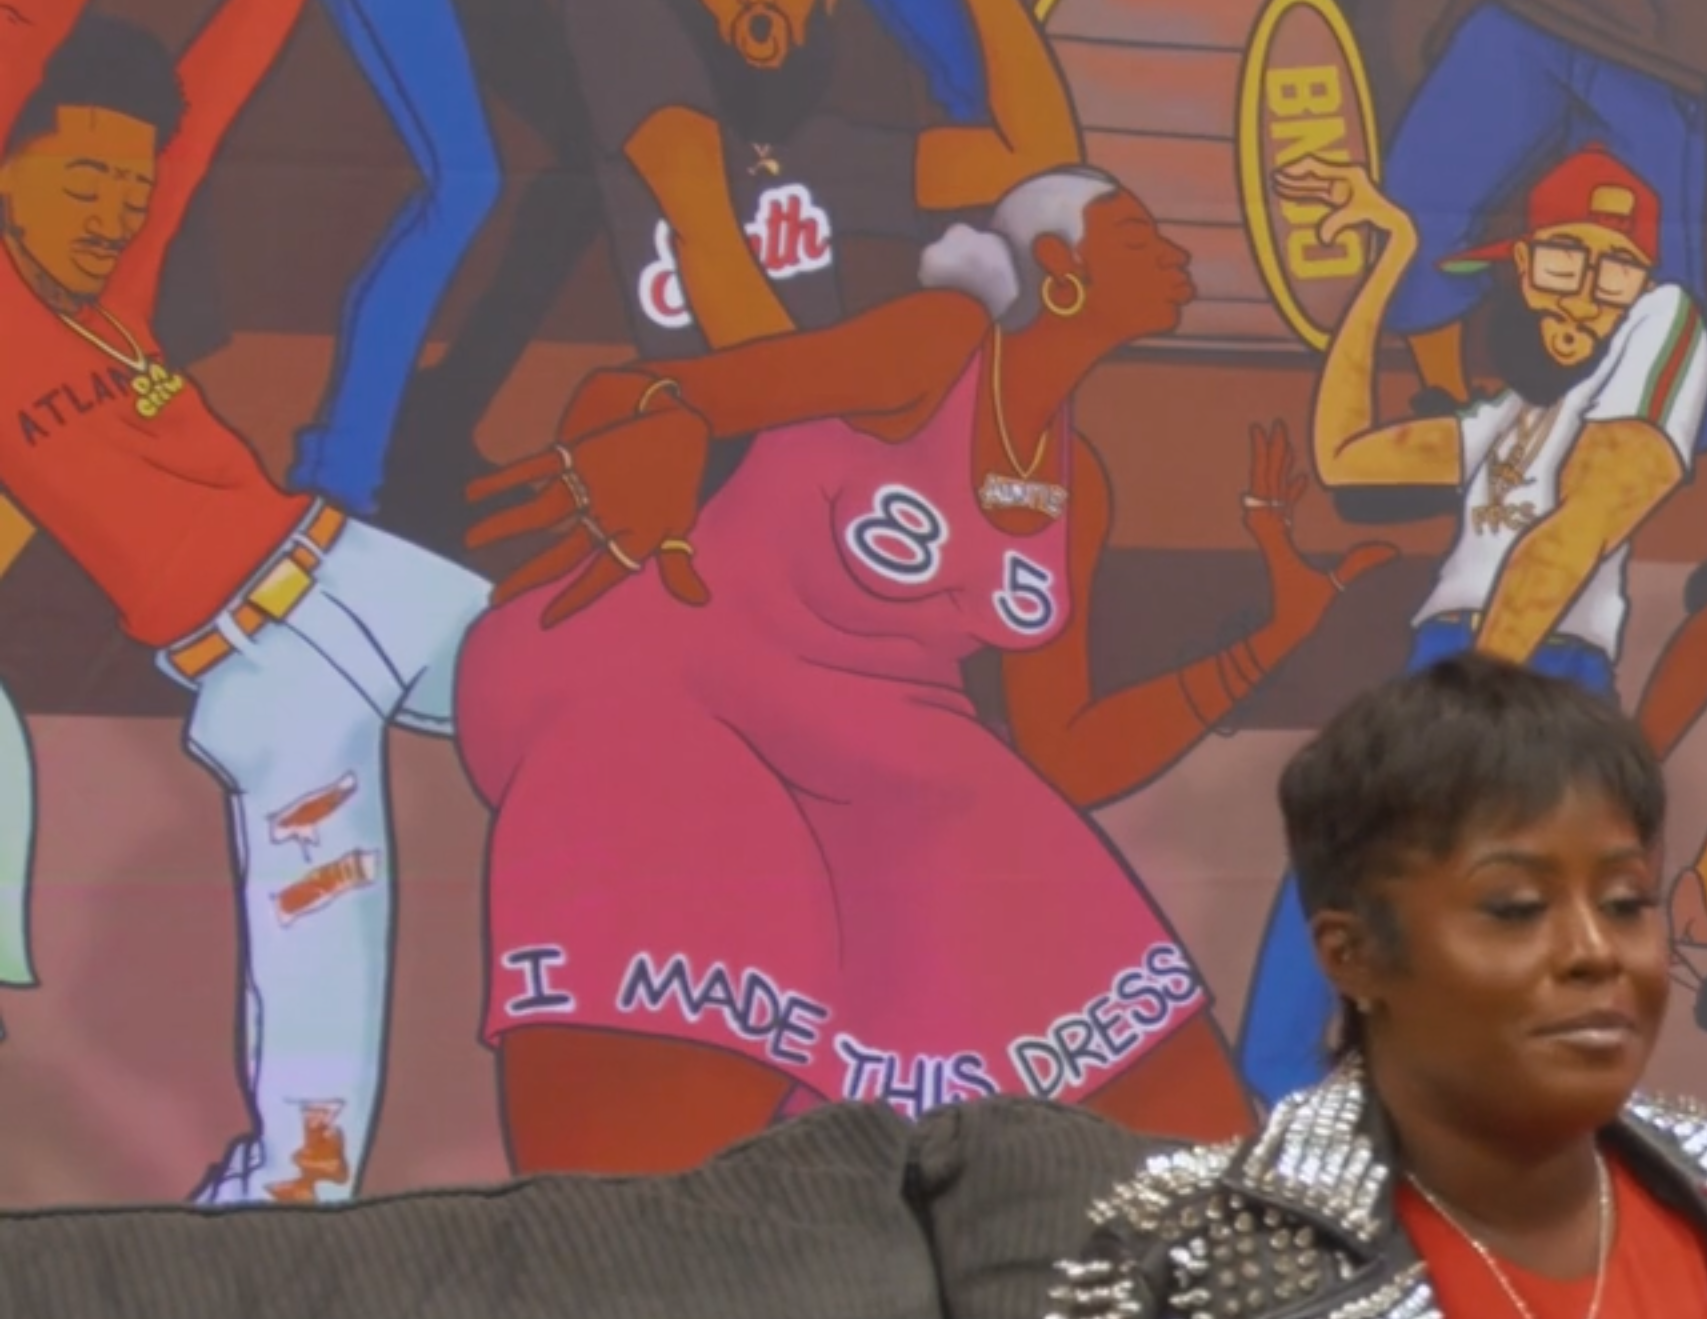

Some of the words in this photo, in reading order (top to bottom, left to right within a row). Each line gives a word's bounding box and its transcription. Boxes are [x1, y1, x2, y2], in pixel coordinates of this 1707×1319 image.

[502, 946, 574, 1013] I
[618, 953, 827, 1064] MADE
[833, 1033, 998, 1118] THIS
[1007, 944, 1206, 1099] DRESS
